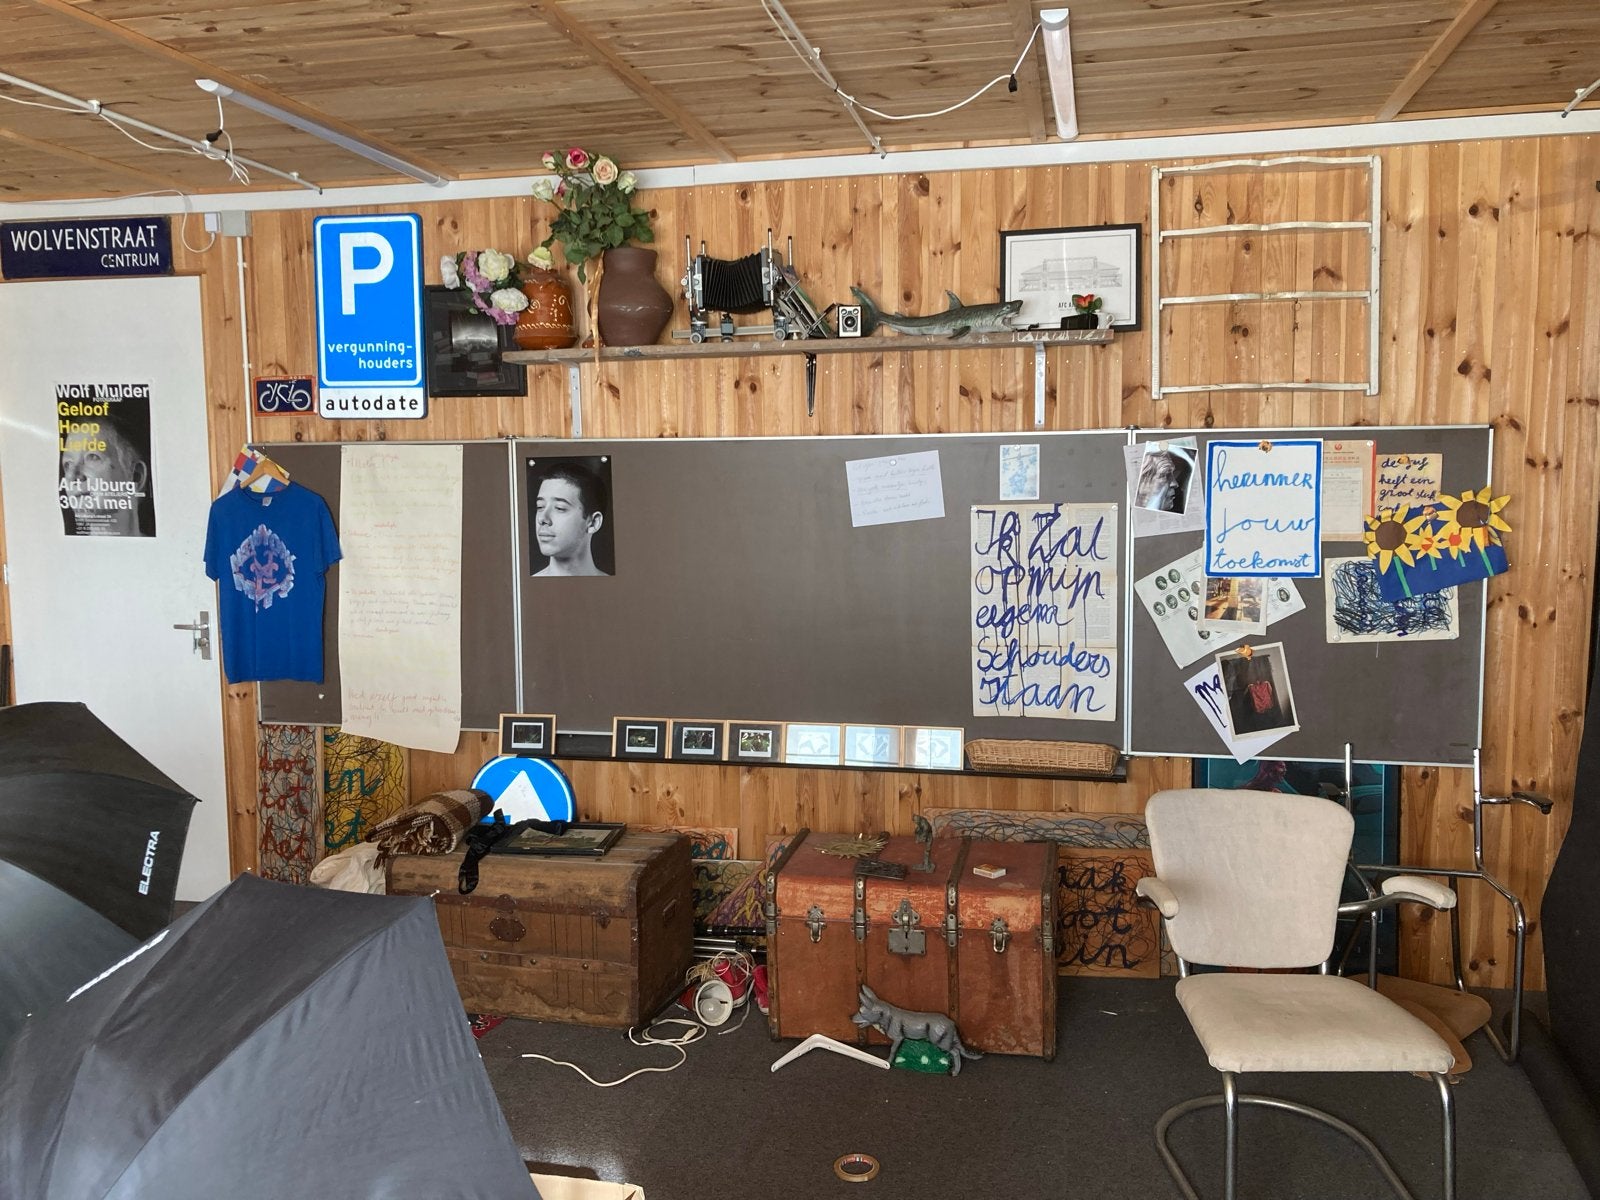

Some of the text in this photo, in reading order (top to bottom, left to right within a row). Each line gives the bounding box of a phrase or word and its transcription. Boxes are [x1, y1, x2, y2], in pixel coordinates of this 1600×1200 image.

[10, 225, 158, 252] WOLVENSTRAAT
[101, 252, 160, 268] CENTRUM
[339, 232, 394, 315] P
[327, 340, 413, 356] vergunning-
[358, 357, 413, 369] houders
[56, 383, 150, 398] Wolf Mulder
[58, 402, 109, 416] Geloof
[325, 395, 418, 411] autodate
[59, 420, 100, 436] Hoop
[59, 437, 107, 452] Liefde
[59, 478, 136, 495] Art IJburg
[60, 495, 133, 509] 30/31 mei
[1213, 548, 1312, 569] toekomst
[138, 831, 160, 895] ELECTRA
